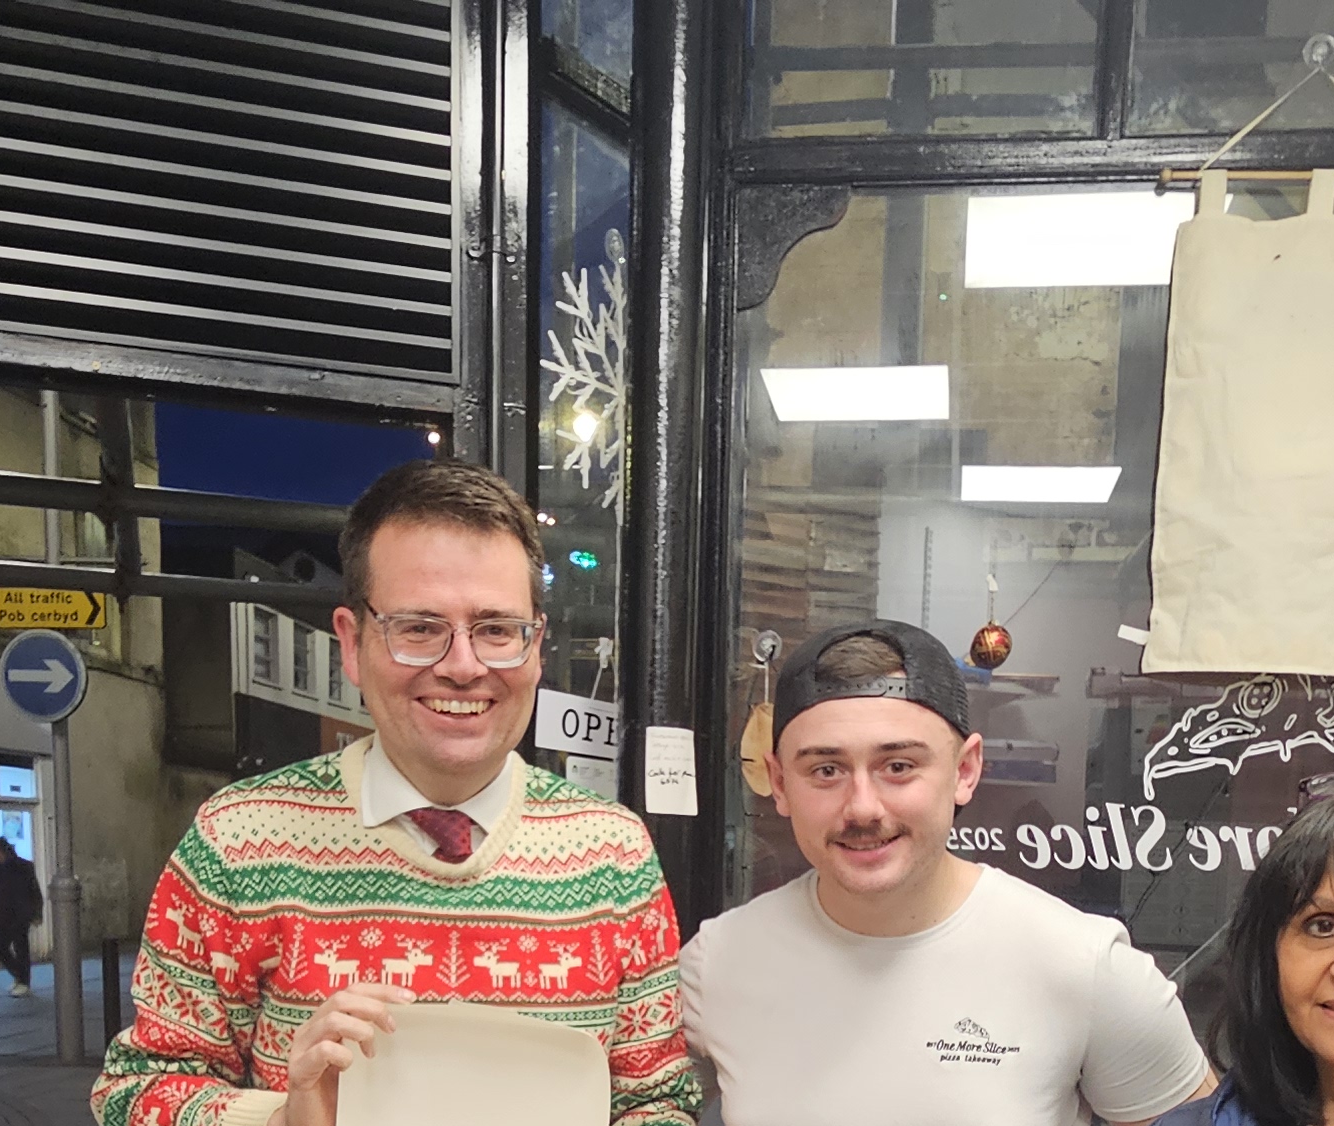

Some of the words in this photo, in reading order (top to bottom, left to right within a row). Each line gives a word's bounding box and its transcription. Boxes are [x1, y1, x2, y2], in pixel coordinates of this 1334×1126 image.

[29, 591, 73, 604] traffic
[30, 609, 79, 624] cerbyd
[936, 1039, 956, 1052] One
[955, 1040, 983, 1053] More
[982, 1041, 1007, 1055] Slice
